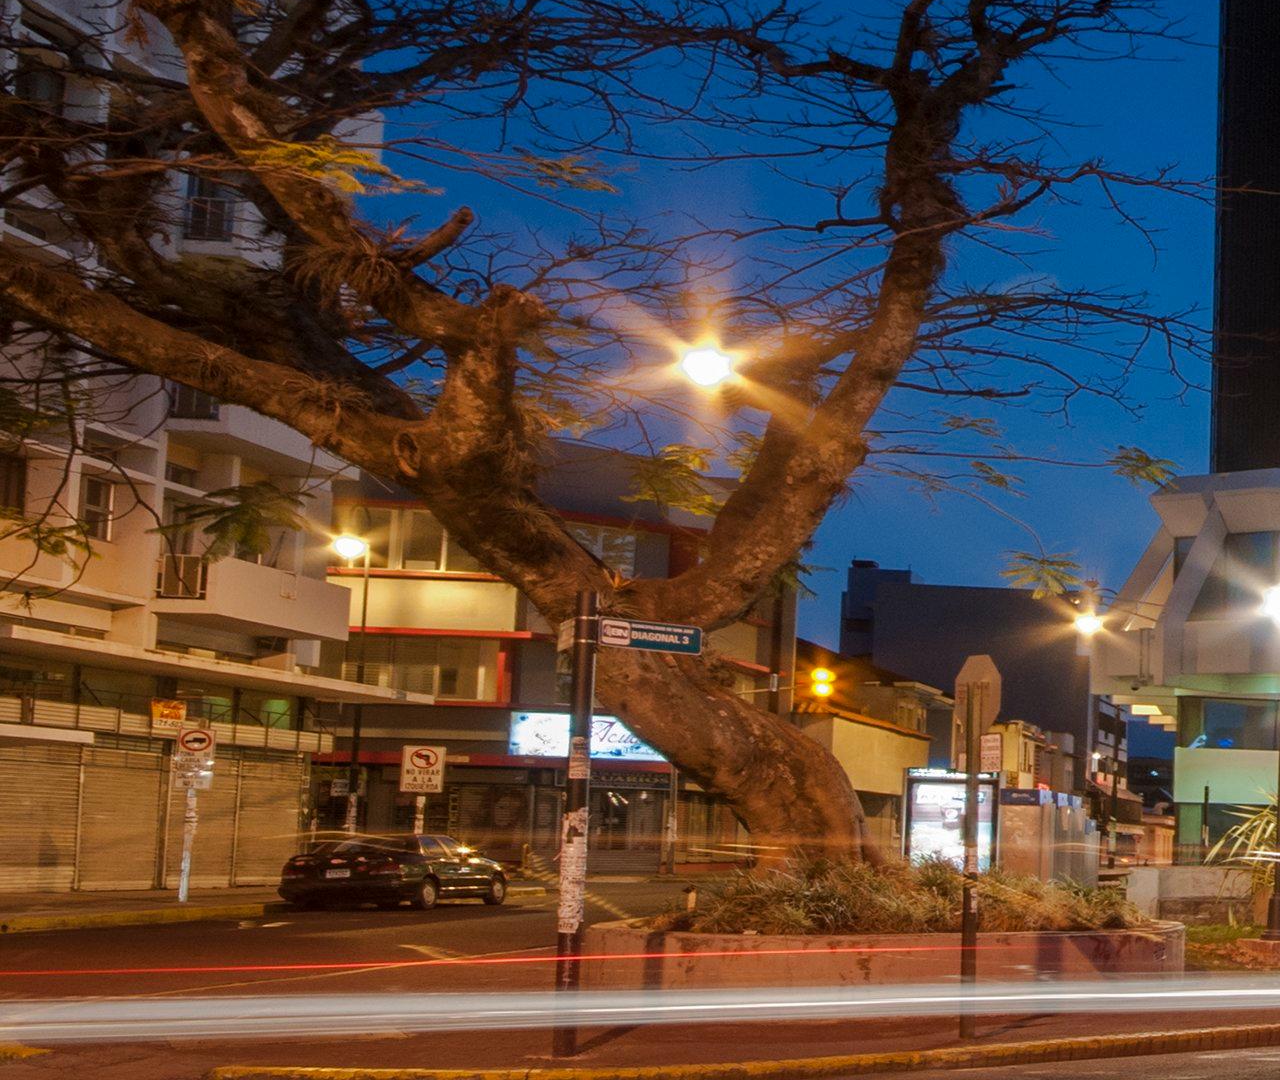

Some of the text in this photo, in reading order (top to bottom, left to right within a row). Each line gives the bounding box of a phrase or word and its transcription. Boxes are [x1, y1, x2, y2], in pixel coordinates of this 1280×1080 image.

[631, 631, 690, 645] DIAGONAL 3
[590, 775, 669, 784] CUARIOS
